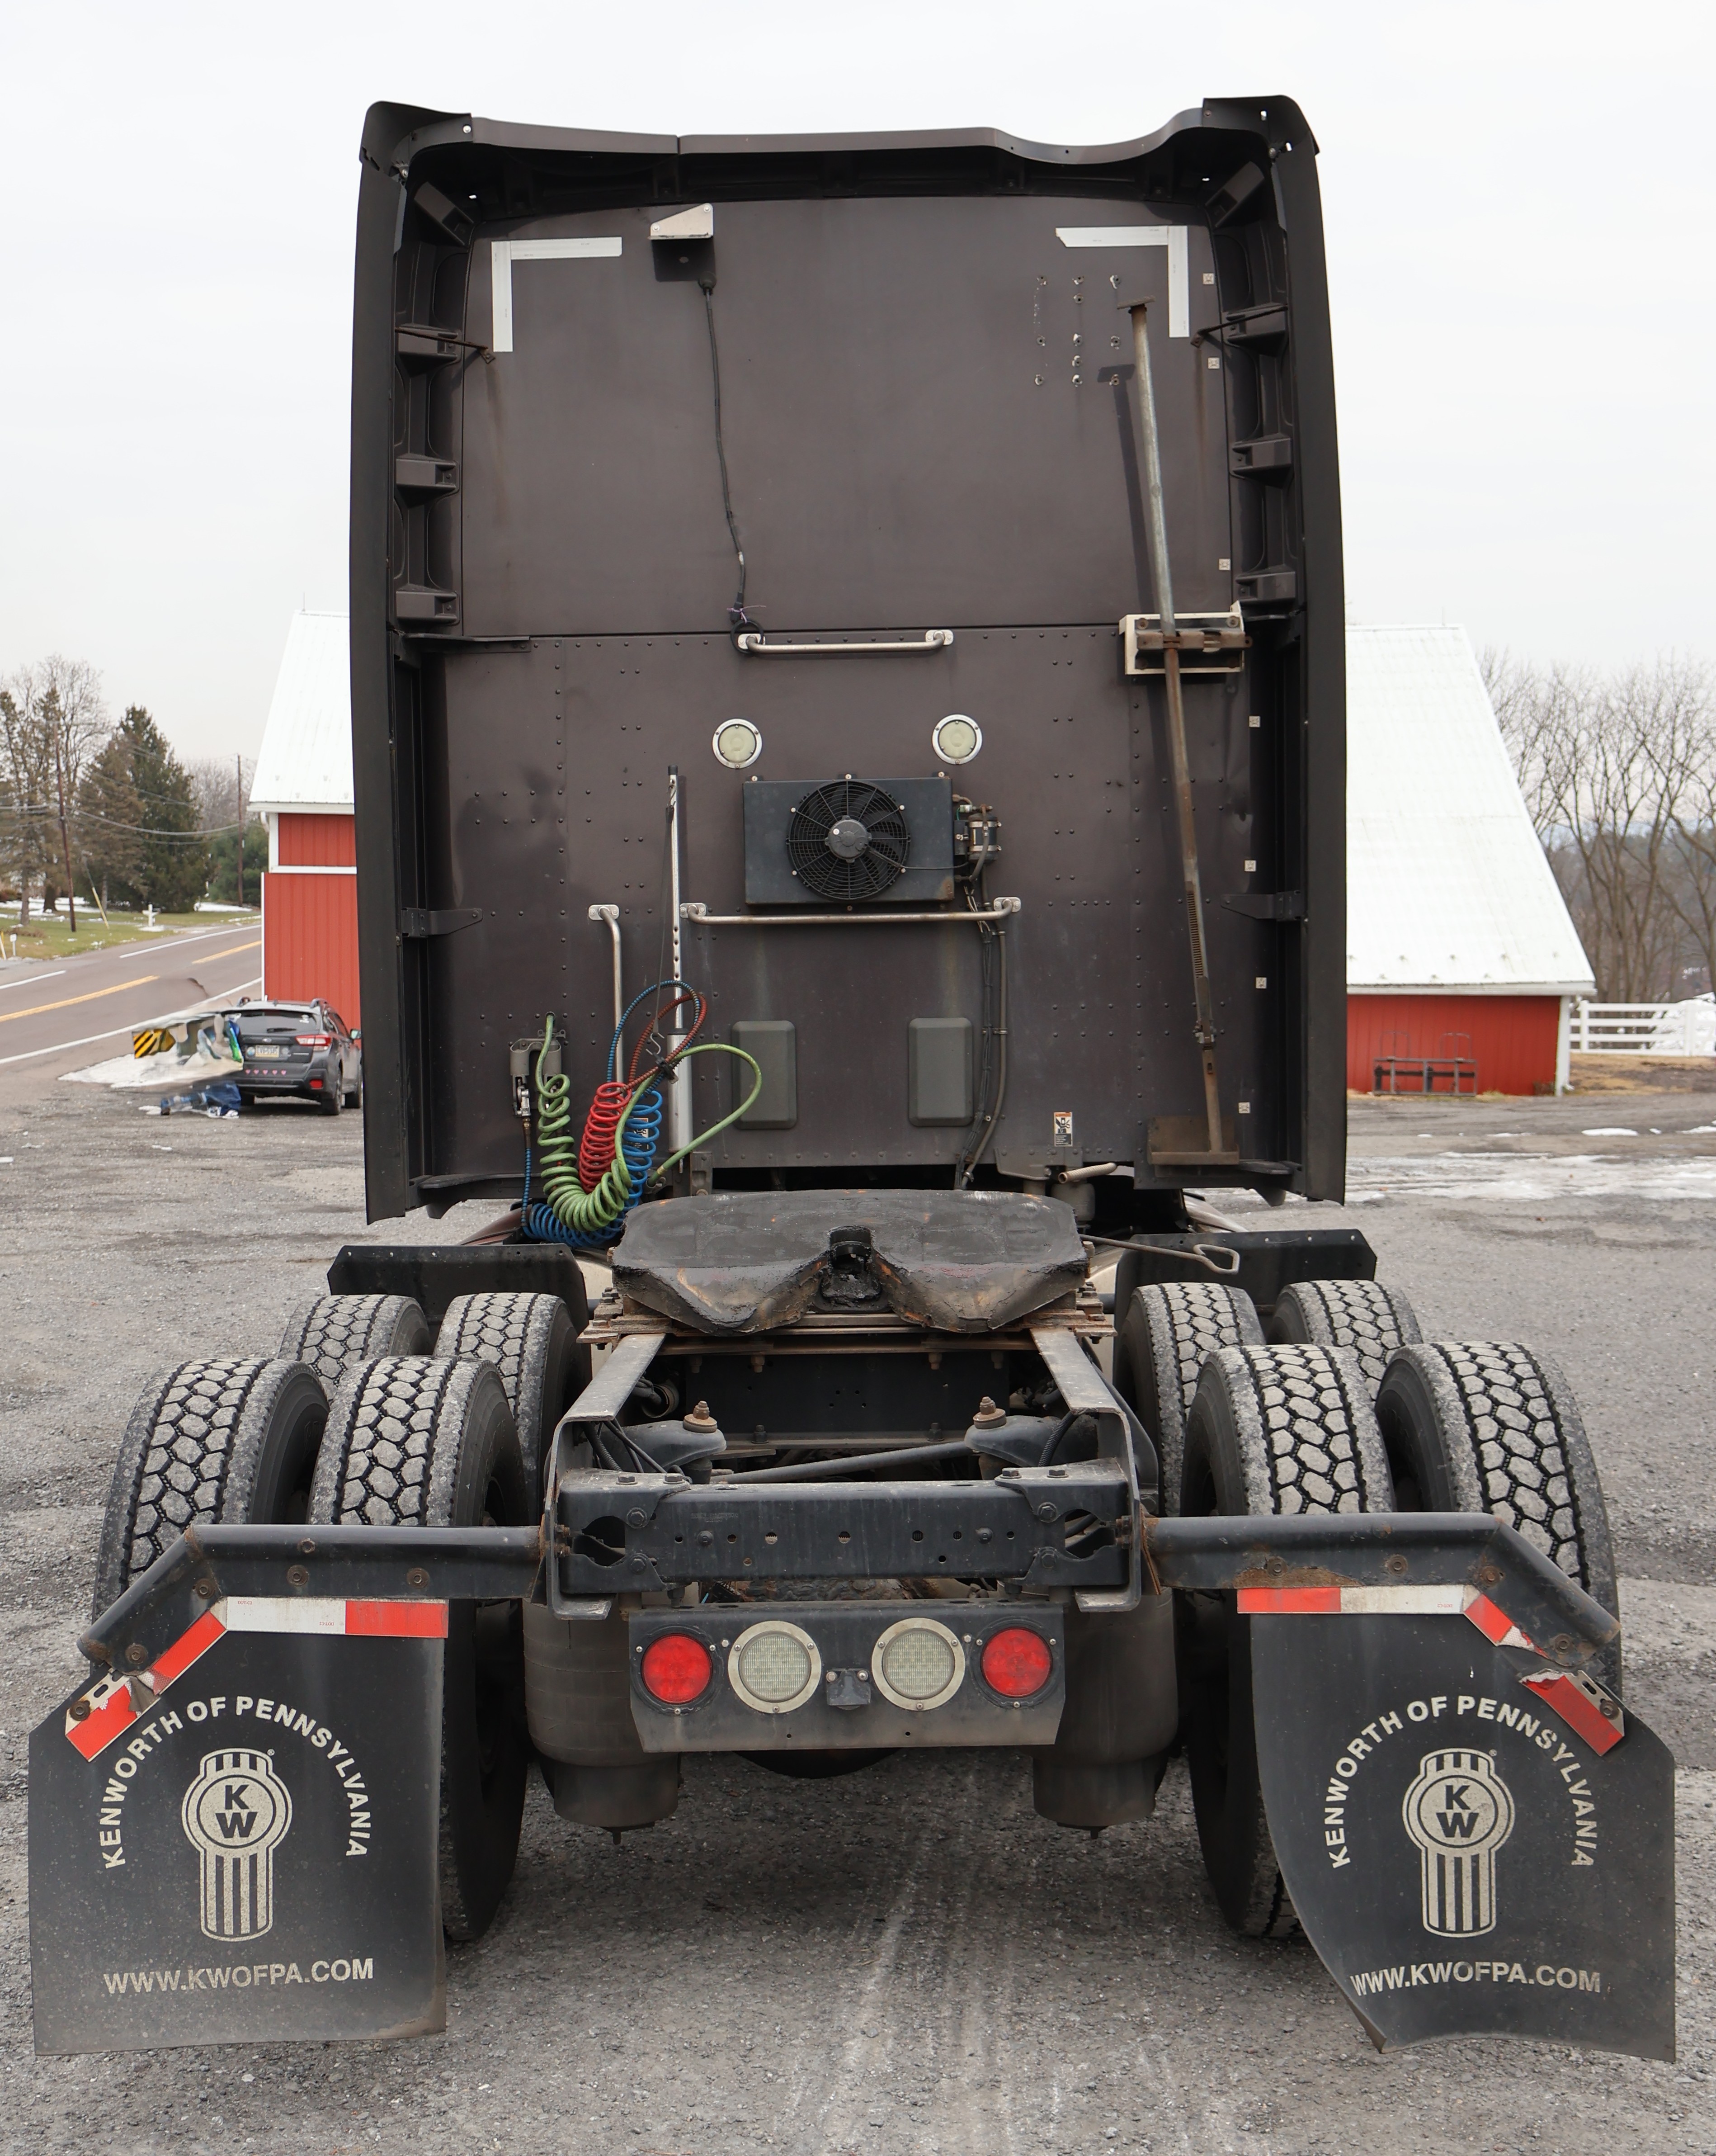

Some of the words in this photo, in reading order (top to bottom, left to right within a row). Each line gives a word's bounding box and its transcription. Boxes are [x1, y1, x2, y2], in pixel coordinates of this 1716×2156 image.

[99, 1711, 183, 1869] KENWORTH
[187, 1697, 226, 1721] OF
[236, 1696, 371, 1856] PENNSYLVANIA
[225, 1784, 250, 1810] K
[1324, 1711, 1403, 1868] KENWORTH
[1407, 1696, 1447, 1721] OF
[1457, 1695, 1597, 1866] PENNSYLVANIA
[1445, 1785, 1471, 1810] K
[215, 1811, 258, 1839] W
[1436, 1812, 1479, 1838] W
[103, 1958, 373, 1995] WWW.KWOFPA.COM
[1350, 1961, 1601, 1996] WWW.KWOFPA.COM
